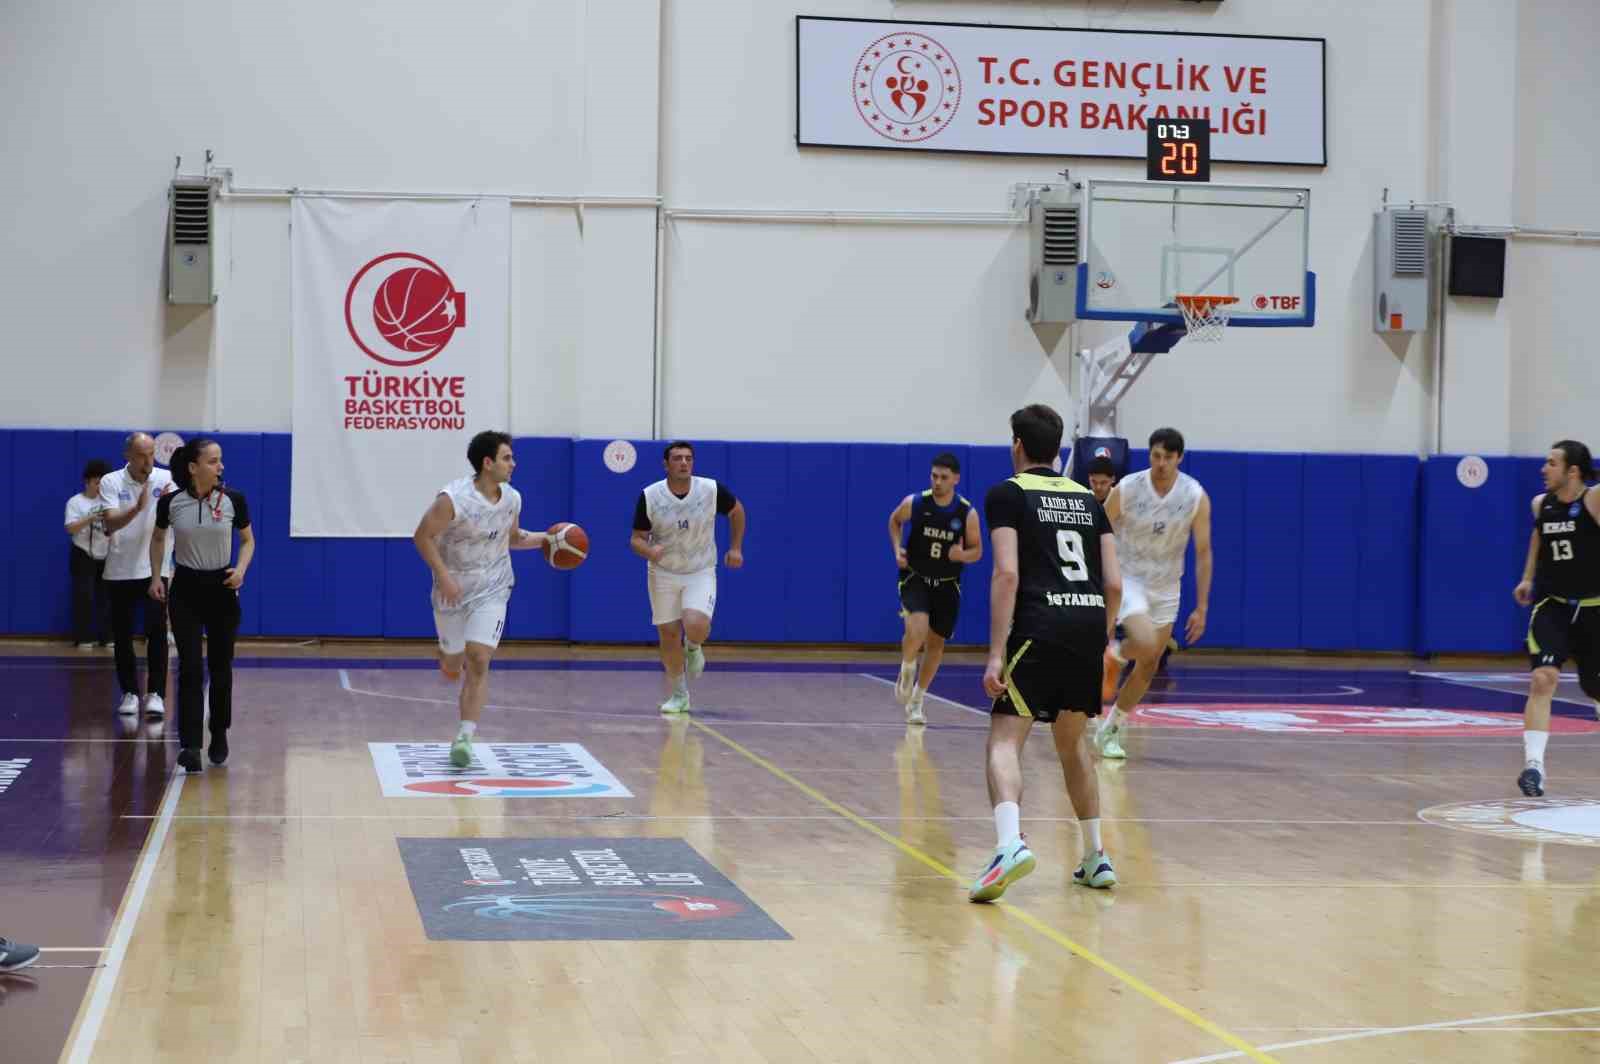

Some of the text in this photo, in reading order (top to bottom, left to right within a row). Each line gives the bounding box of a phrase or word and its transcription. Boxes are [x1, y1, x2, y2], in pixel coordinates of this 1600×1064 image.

[978, 56, 1267, 97] T.C. GENÇLİK VE
[977, 98, 1068, 128] SPOR
[1161, 143, 1197, 174] 20
[1270, 296, 1301, 309] TBF
[344, 370, 465, 398] TÜRKİYE
[344, 399, 466, 415] BASKETBOL
[344, 416, 465, 430] FEDERASYONU
[1068, 498, 1086, 511] HAS
[930, 541, 943, 559] 6
[1056, 529, 1089, 582] 9
[1551, 539, 1574, 561] 13
